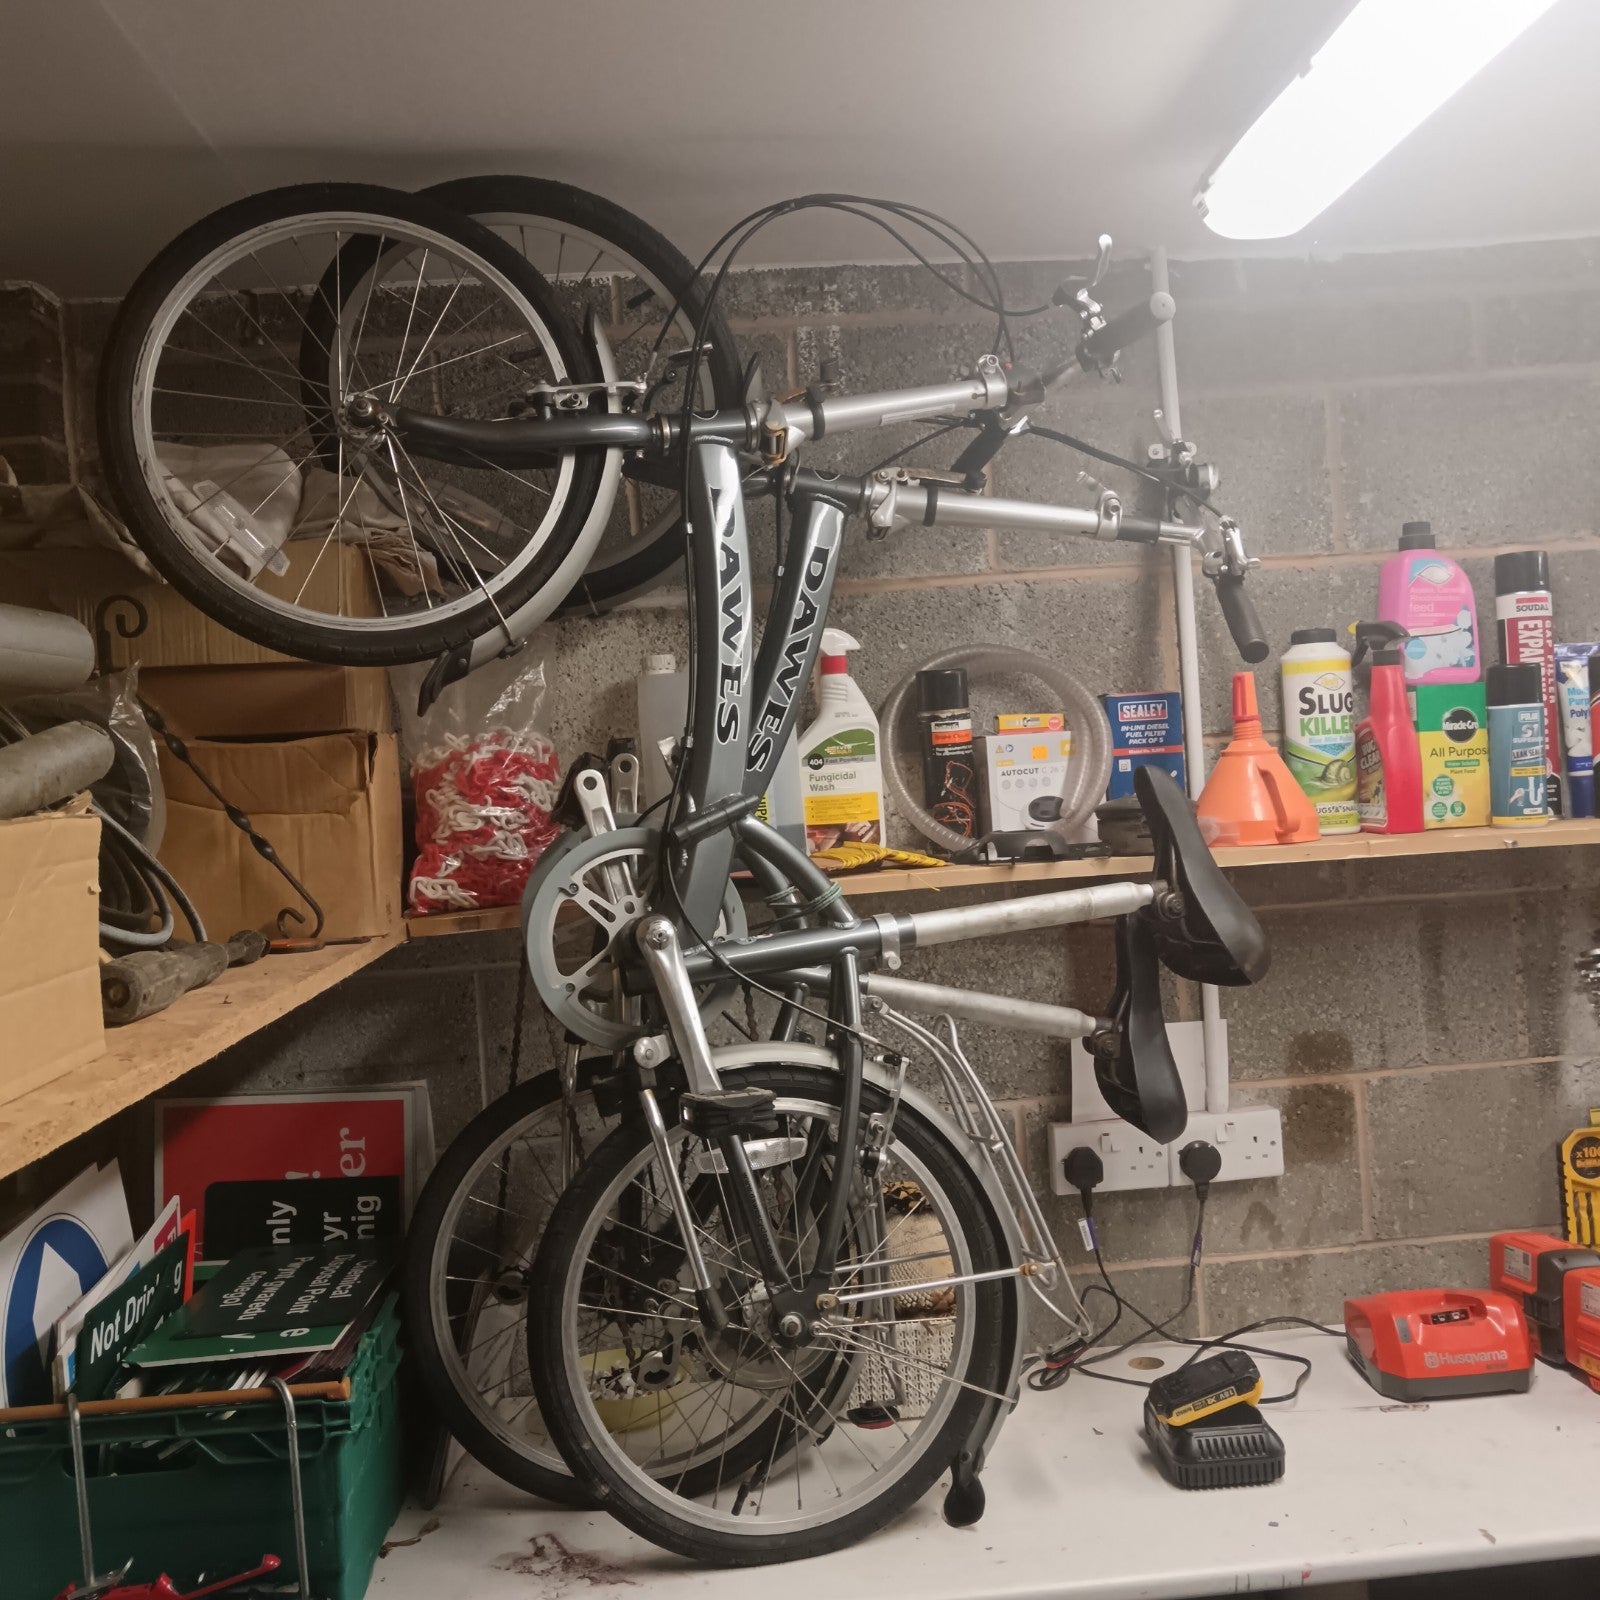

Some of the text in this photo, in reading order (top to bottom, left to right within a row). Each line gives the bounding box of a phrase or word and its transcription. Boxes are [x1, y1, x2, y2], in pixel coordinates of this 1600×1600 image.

[709, 486, 744, 745] DAWES
[1516, 604, 1549, 612] SOUDAL
[746, 545, 830, 772] DAWES
[1122, 703, 1163, 718] SEALEY
[1299, 686, 1353, 716] SLUG
[1430, 745, 1488, 758] All Purpos
[809, 771, 857, 783] Fungicidal
[1001, 767, 1039, 776] AUTOCUT
[810, 784, 835, 792] Wash
[1316, 805, 1333, 815] UGS
[266, 1200, 297, 1244] nly
[351, 1195, 381, 1239] nig
[309, 1254, 356, 1288] Disposal
[329, 1259, 377, 1299] Chemical
[219, 1270, 268, 1308] cemegol
[237, 1256, 314, 1321] Pwynt gwaredu
[286, 1287, 326, 1315] Point
[90, 1308, 121, 1365] Not
[1439, 1349, 1508, 1366] Husqvarna
